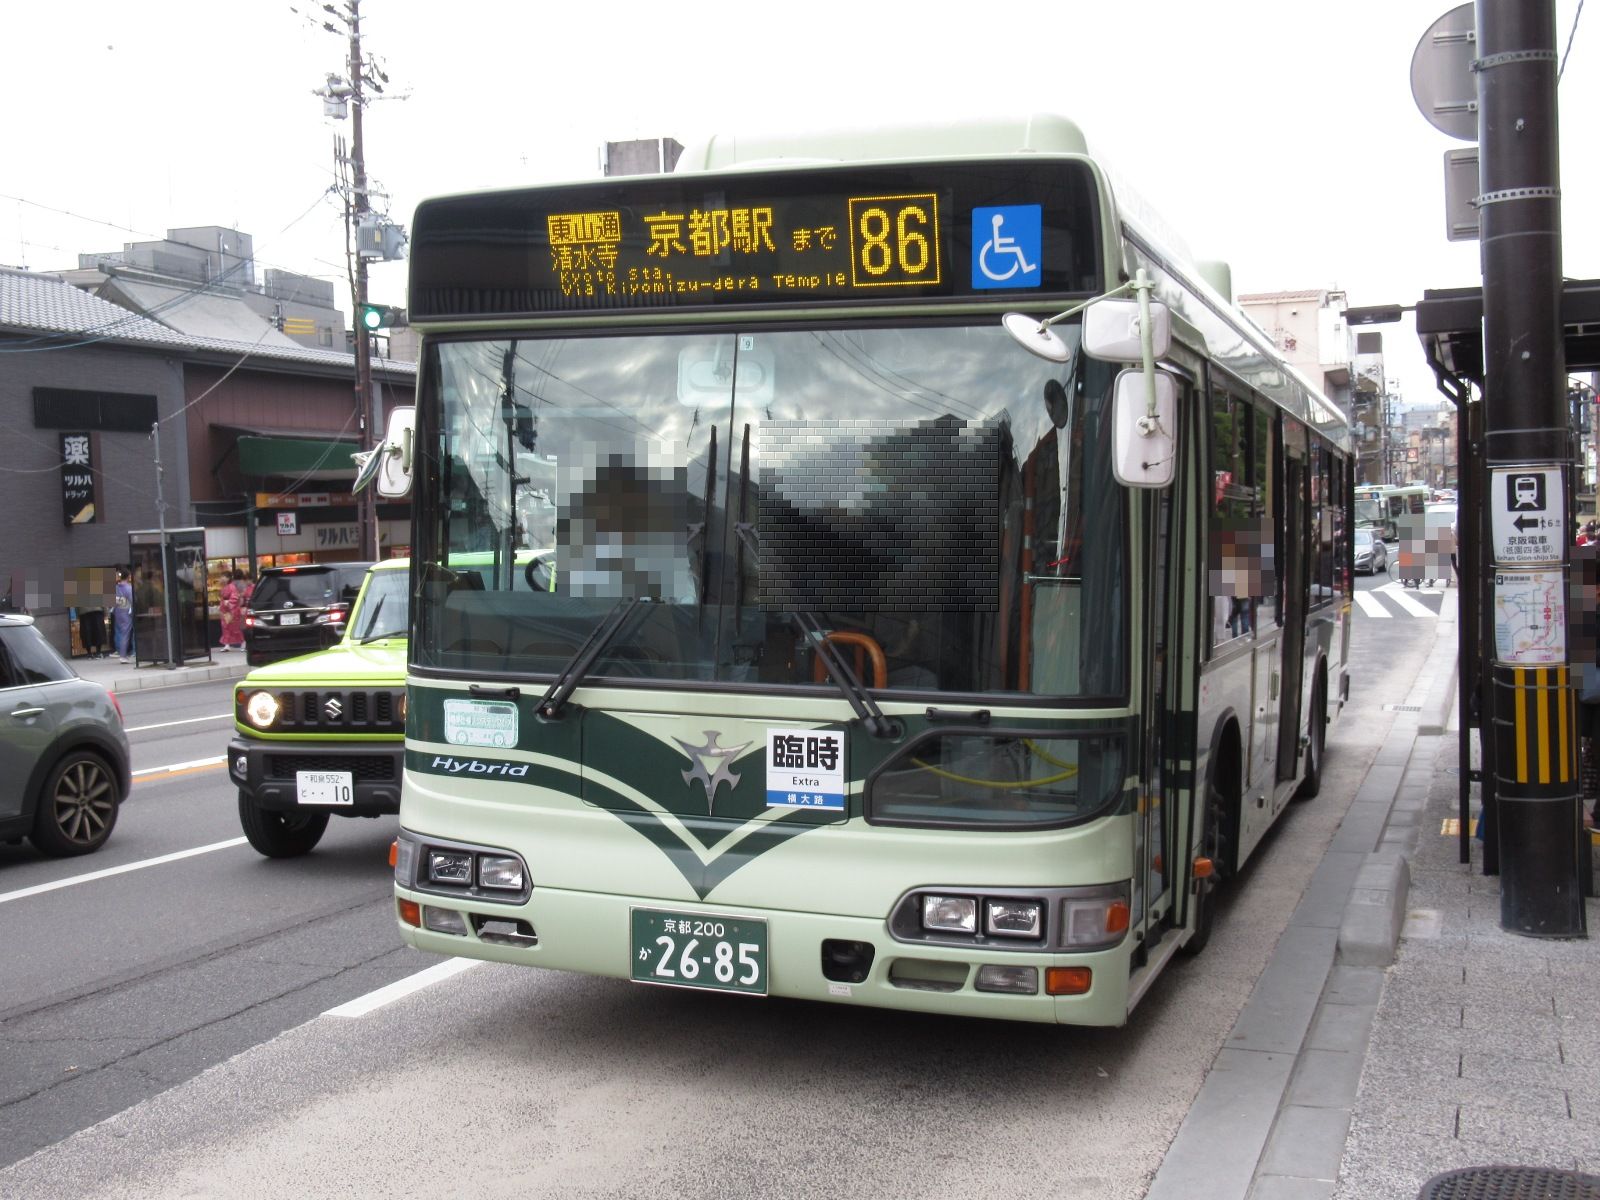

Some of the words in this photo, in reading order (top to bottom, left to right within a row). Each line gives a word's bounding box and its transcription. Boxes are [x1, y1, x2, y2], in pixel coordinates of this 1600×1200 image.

[548, 211, 620, 244] 東山通
[644, 208, 775, 257] 京都駅
[793, 226, 836, 251] まで
[861, 206, 928, 275] 86
[551, 243, 618, 270] 清水寺
[561, 270, 614, 284] Kyoto
[773, 273, 845, 288] Temple
[64, 436, 89, 465] 薬
[64, 475, 92, 486] ツルハ
[1508, 535, 1547, 545] 京阪電車
[773, 734, 839, 770] 臨時
[431, 756, 529, 776] Hybrid
[792, 776, 820, 787] Extra
[787, 793, 824, 805] 横大路
[639, 946, 652, 960] か
[655, 935, 760, 985] 26-85
